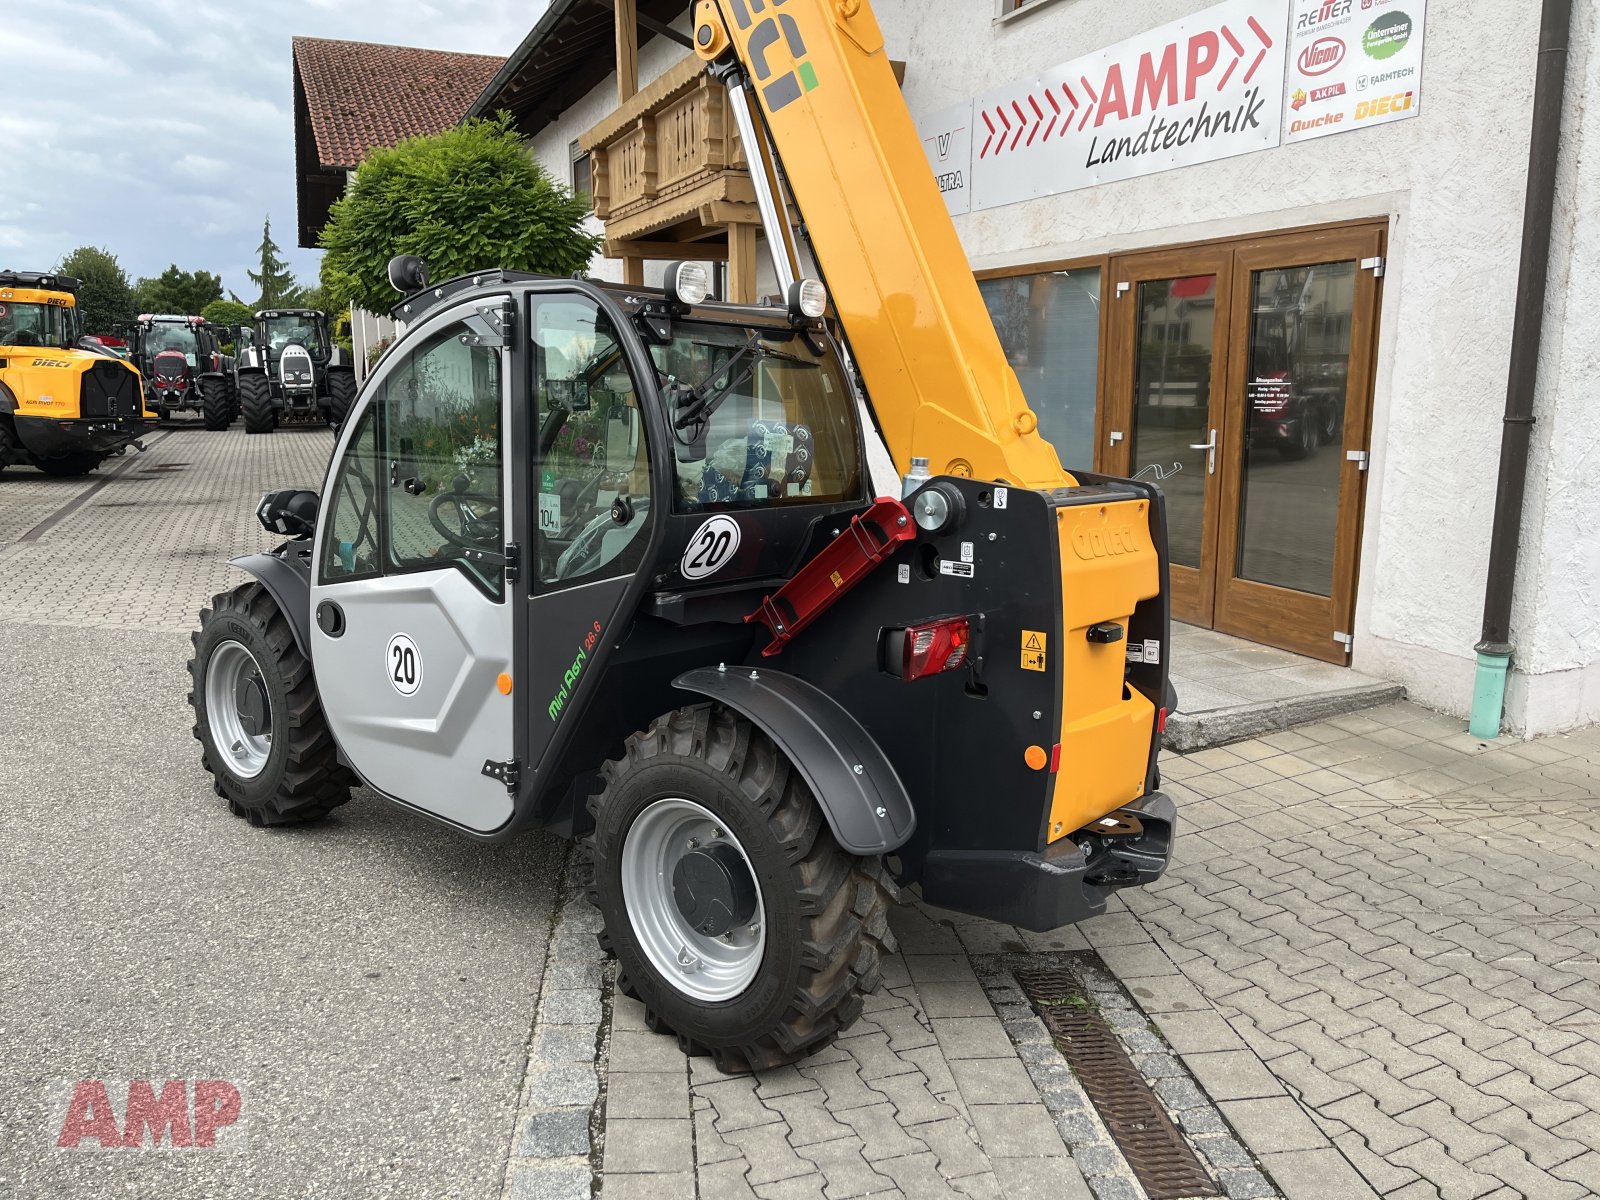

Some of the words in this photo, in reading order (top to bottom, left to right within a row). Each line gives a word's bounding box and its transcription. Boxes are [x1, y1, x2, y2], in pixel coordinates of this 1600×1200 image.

[1367, 22, 1409, 39] Unterreiner
[1304, 44, 1341, 69] Vicon
[1094, 30, 1220, 128] AMP
[1370, 67, 1414, 86] FARMTECH
[1314, 85, 1341, 99] AKPIL
[1085, 86, 1265, 169] Landtechnik
[1290, 112, 1344, 133] Quicke
[935, 170, 963, 193] LTRA
[540, 508, 555, 529] 104
[688, 530, 731, 569] 20
[584, 620, 601, 651] 26.6
[393, 645, 416, 685] 20
